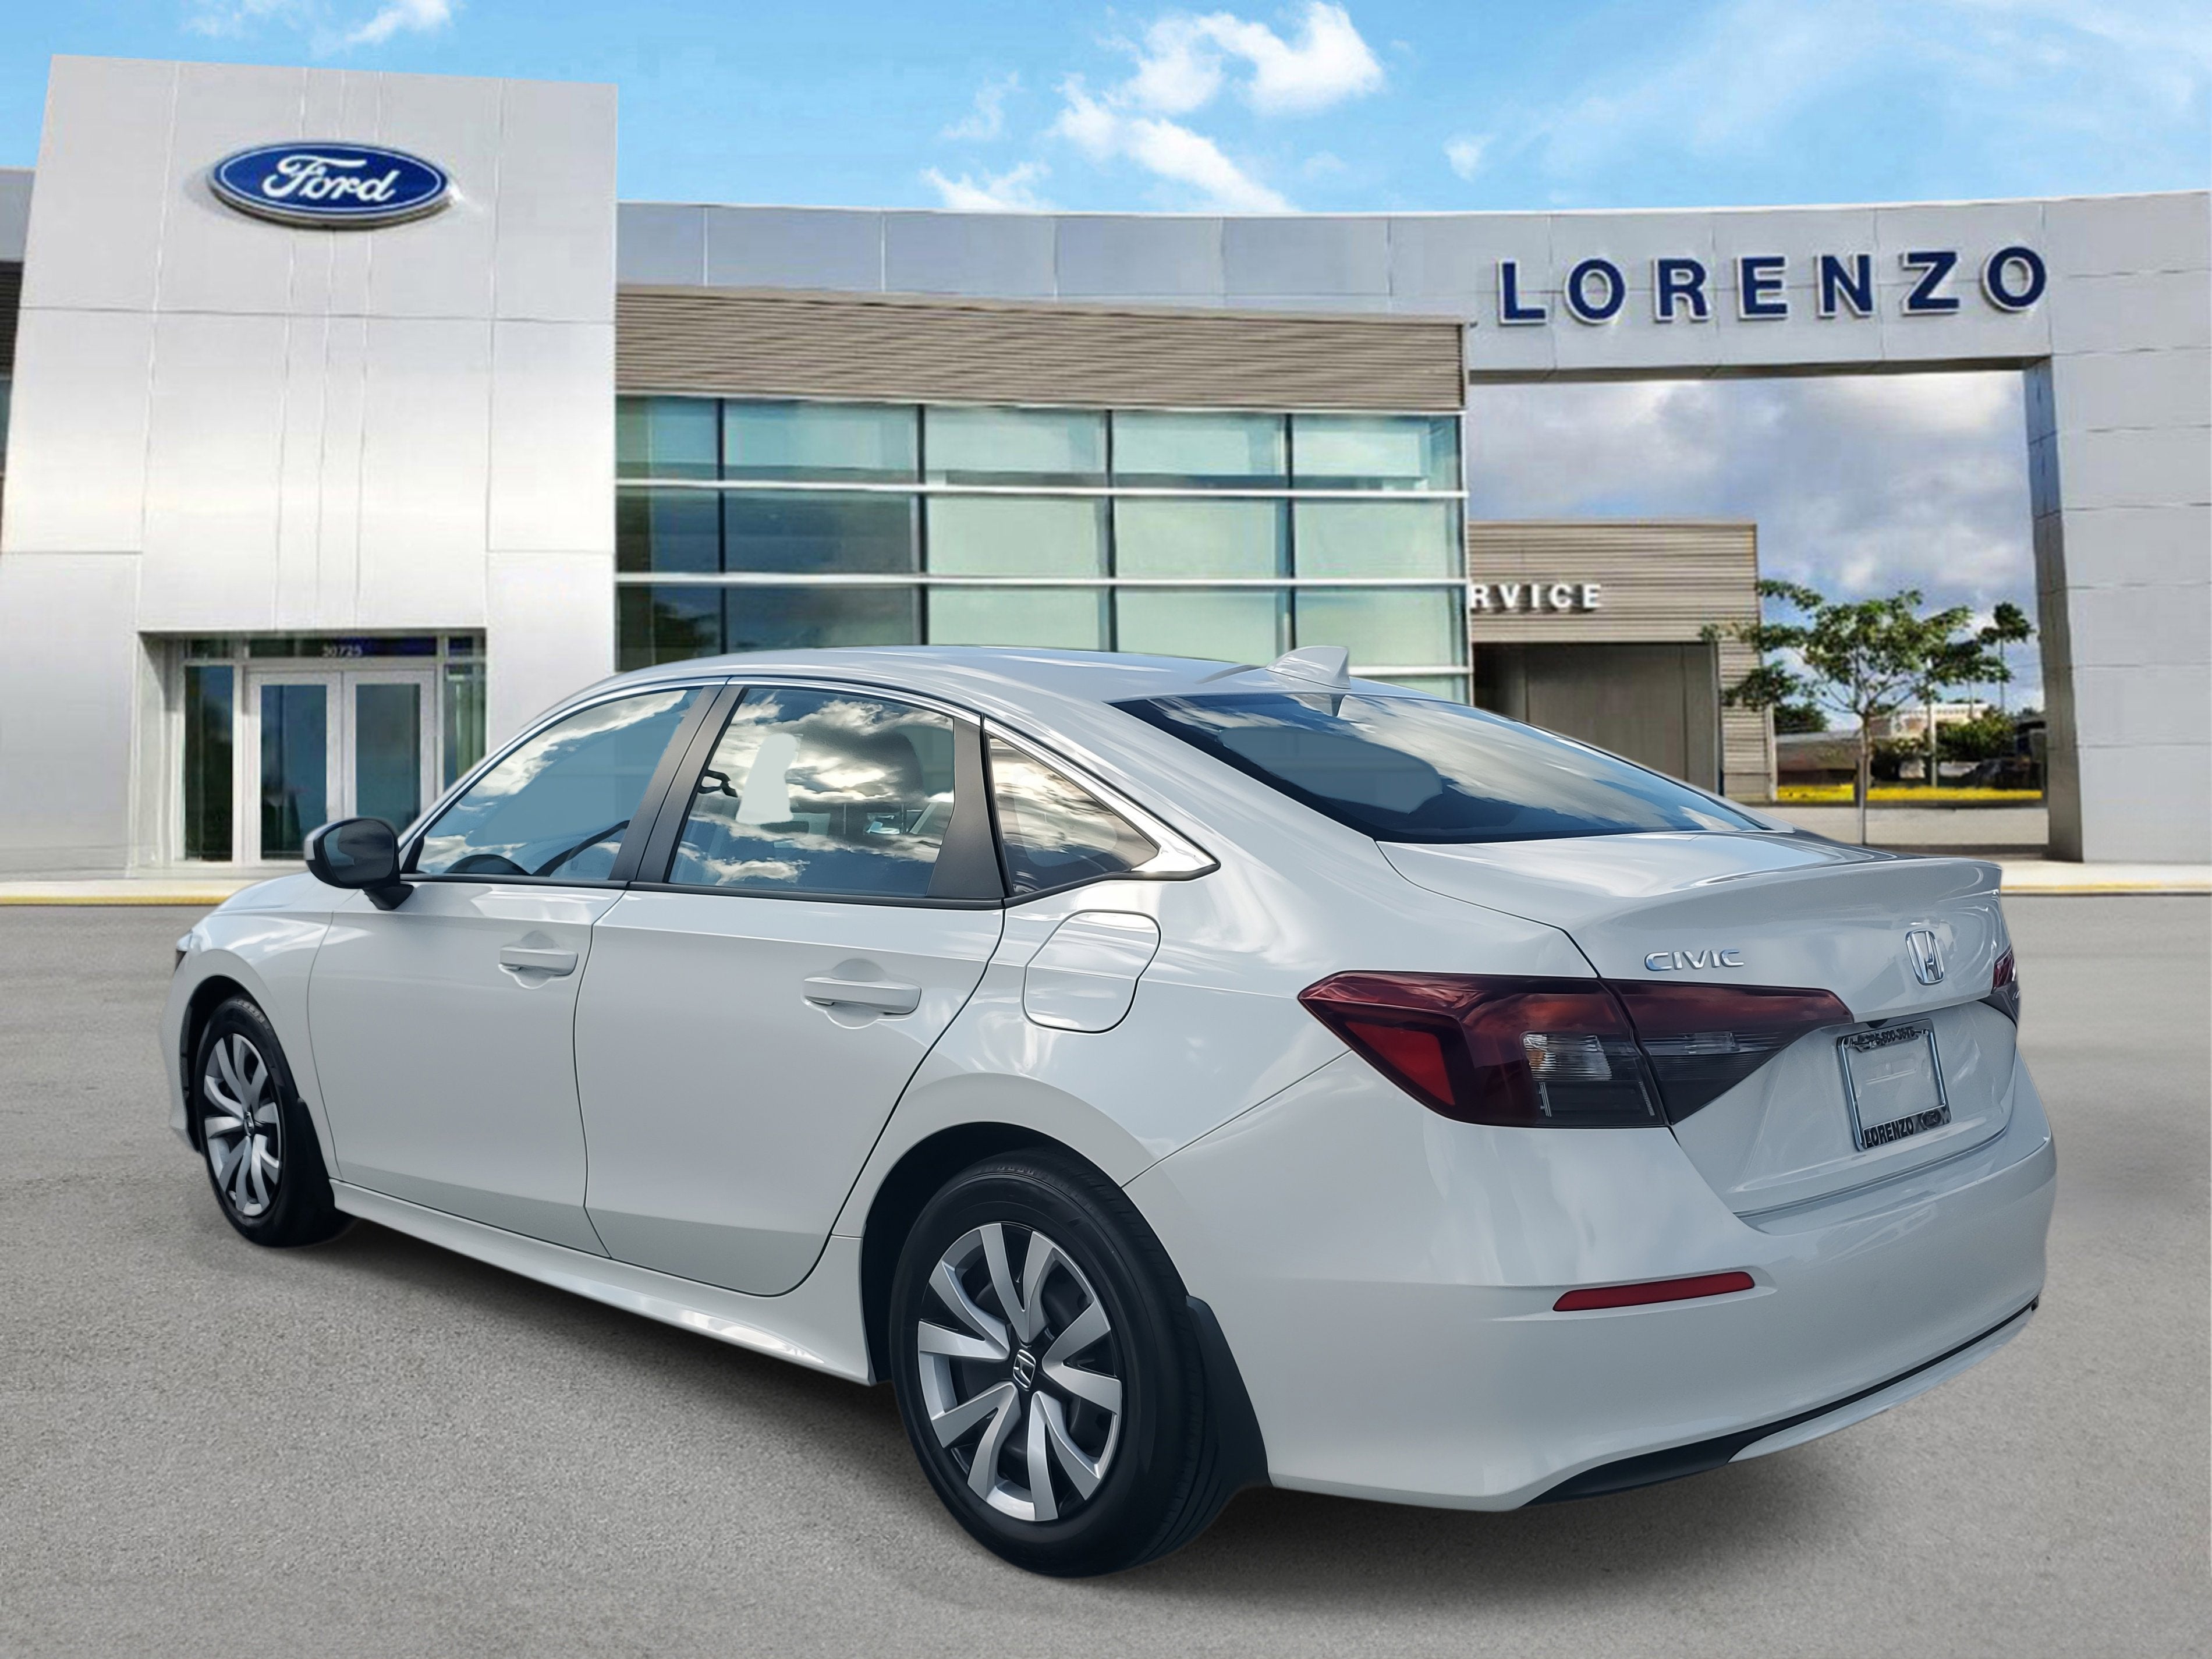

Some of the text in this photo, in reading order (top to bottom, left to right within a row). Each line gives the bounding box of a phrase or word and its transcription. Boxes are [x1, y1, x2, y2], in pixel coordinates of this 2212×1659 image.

[263, 154, 400, 202] Ford
[1500, 244, 2047, 323] LORENZO
[1644, 948, 1745, 972] CIVIC
[1864, 1116, 1914, 1148] LORENZO
